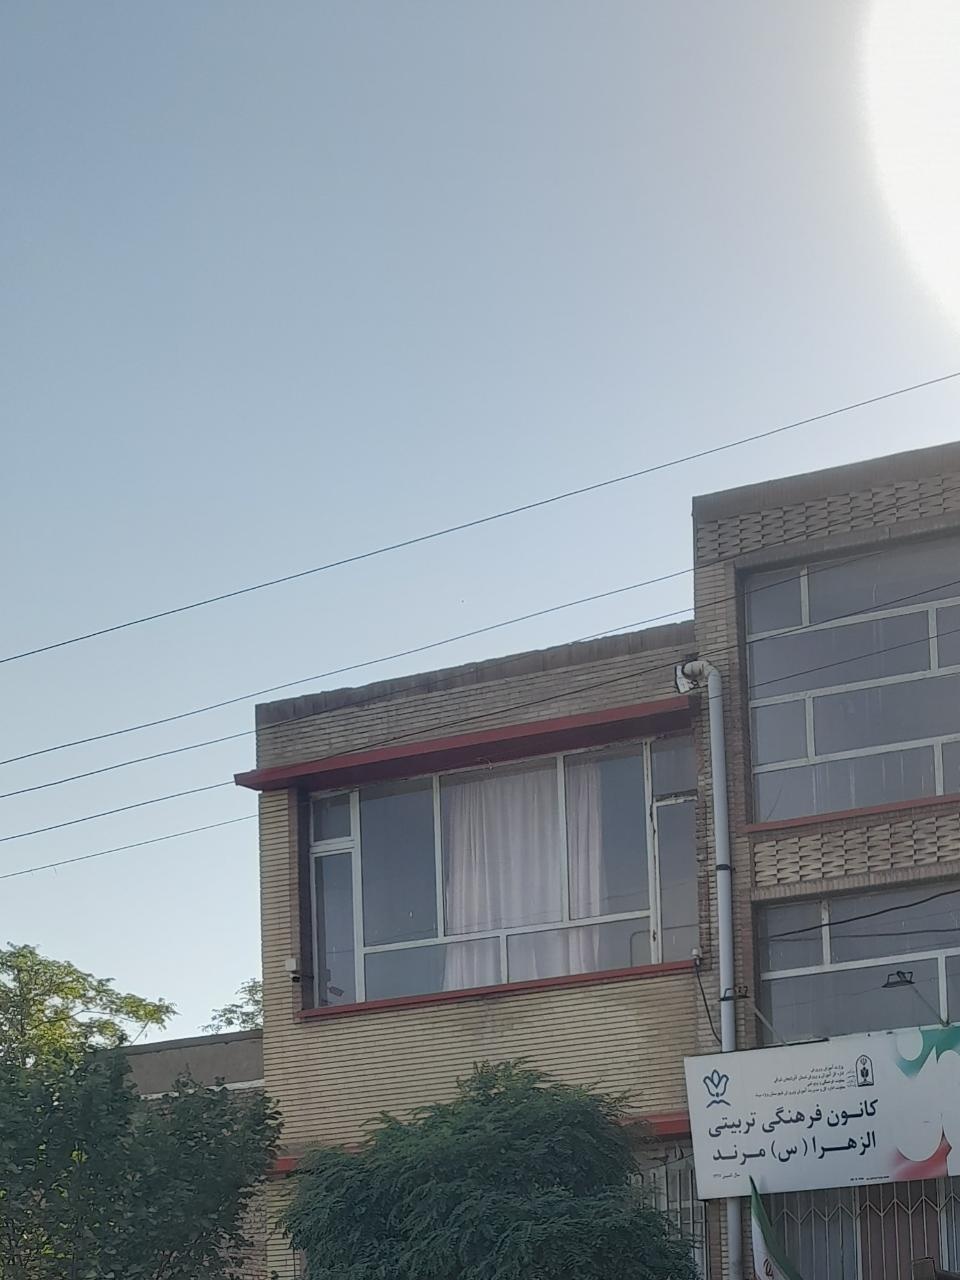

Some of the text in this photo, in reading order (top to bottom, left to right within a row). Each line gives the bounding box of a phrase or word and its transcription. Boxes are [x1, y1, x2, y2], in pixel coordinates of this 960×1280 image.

[708, 1098, 879, 1137] کانون فرهنگی تربیتی
[712, 1143, 766, 1165] مرند
[812, 1130, 877, 1160] الزهرا
